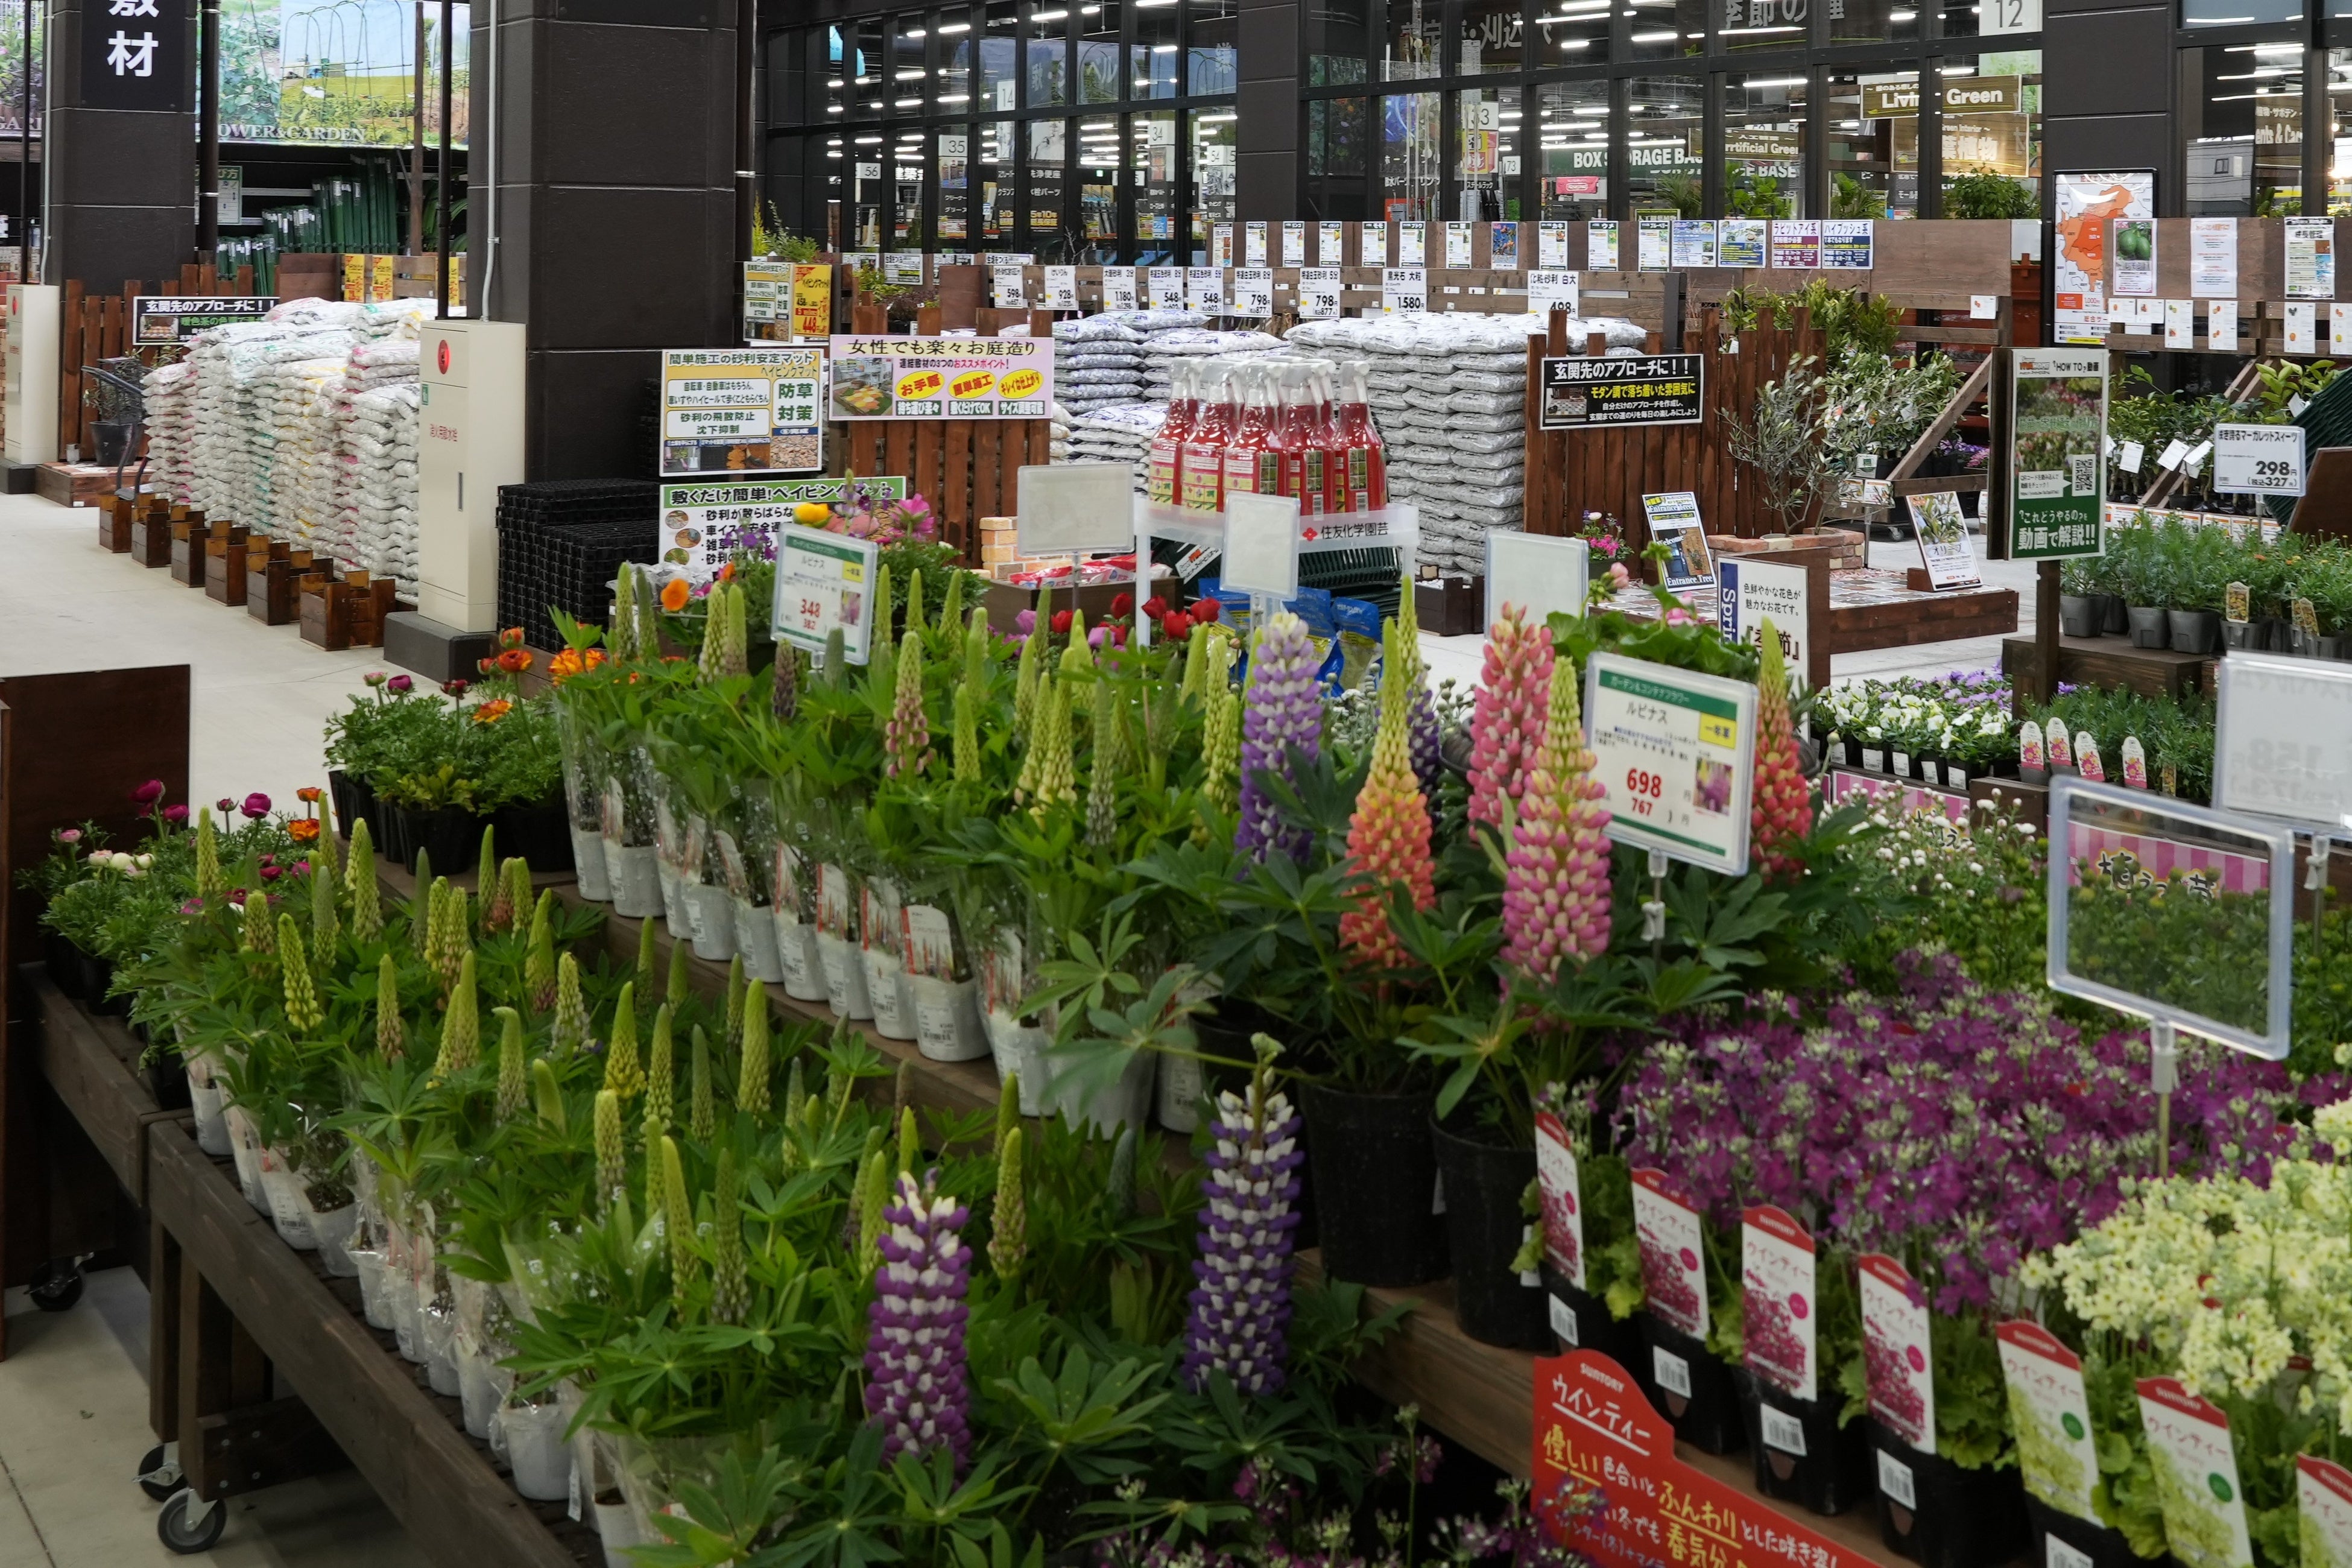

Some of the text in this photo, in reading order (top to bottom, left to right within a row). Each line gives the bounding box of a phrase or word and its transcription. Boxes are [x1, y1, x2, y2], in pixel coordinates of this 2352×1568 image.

[1997, 0, 2023, 28] 12
[1002, 89, 1014, 107] 14
[1946, 88, 2003, 104] Green
[1152, 128, 1163, 141] 34
[948, 140, 965, 153] 35
[1506, 161, 1516, 171] 73
[1573, 151, 1602, 168] BOX
[864, 166, 878, 177] 56
[1758, 166, 1797, 178] BASE
[1387, 271, 1406, 281] 黒光石
[847, 339, 1035, 356] 女性でも楽々お庭造り
[669, 353, 817, 365] 簡単施工の砂利安定マット
[779, 383, 814, 399] 防草
[901, 373, 941, 397] お手軽
[953, 374, 993, 396] 簡単施工
[1591, 382, 1696, 399] モダン調で落ち着いた雰囲気に
[778, 405, 813, 421] 対策
[1602, 399, 1684, 411] 自分だけのアプローチを作成し、
[680, 412, 756, 422] 砂利の飛散防止
[1589, 409, 1697, 422] 玄関までの道のりを毎日の楽しみにしよう
[697, 425, 740, 435] 沈下抑制
[1321, 522, 1388, 540] 住友化学園芸
[1667, 574, 1713, 586] Entrance Tree
[1743, 583, 1801, 600] 色鮮やかな花色が
[800, 598, 821, 618] 348
[1721, 587, 1736, 643] Sprin
[1746, 598, 1799, 616] 魅力なお花です。
[1704, 724, 1730, 739] 一年草
[1627, 768, 1662, 798] 698
[1632, 797, 1652, 817] 767
[1579, 1362, 1625, 1394] SUNTORY
